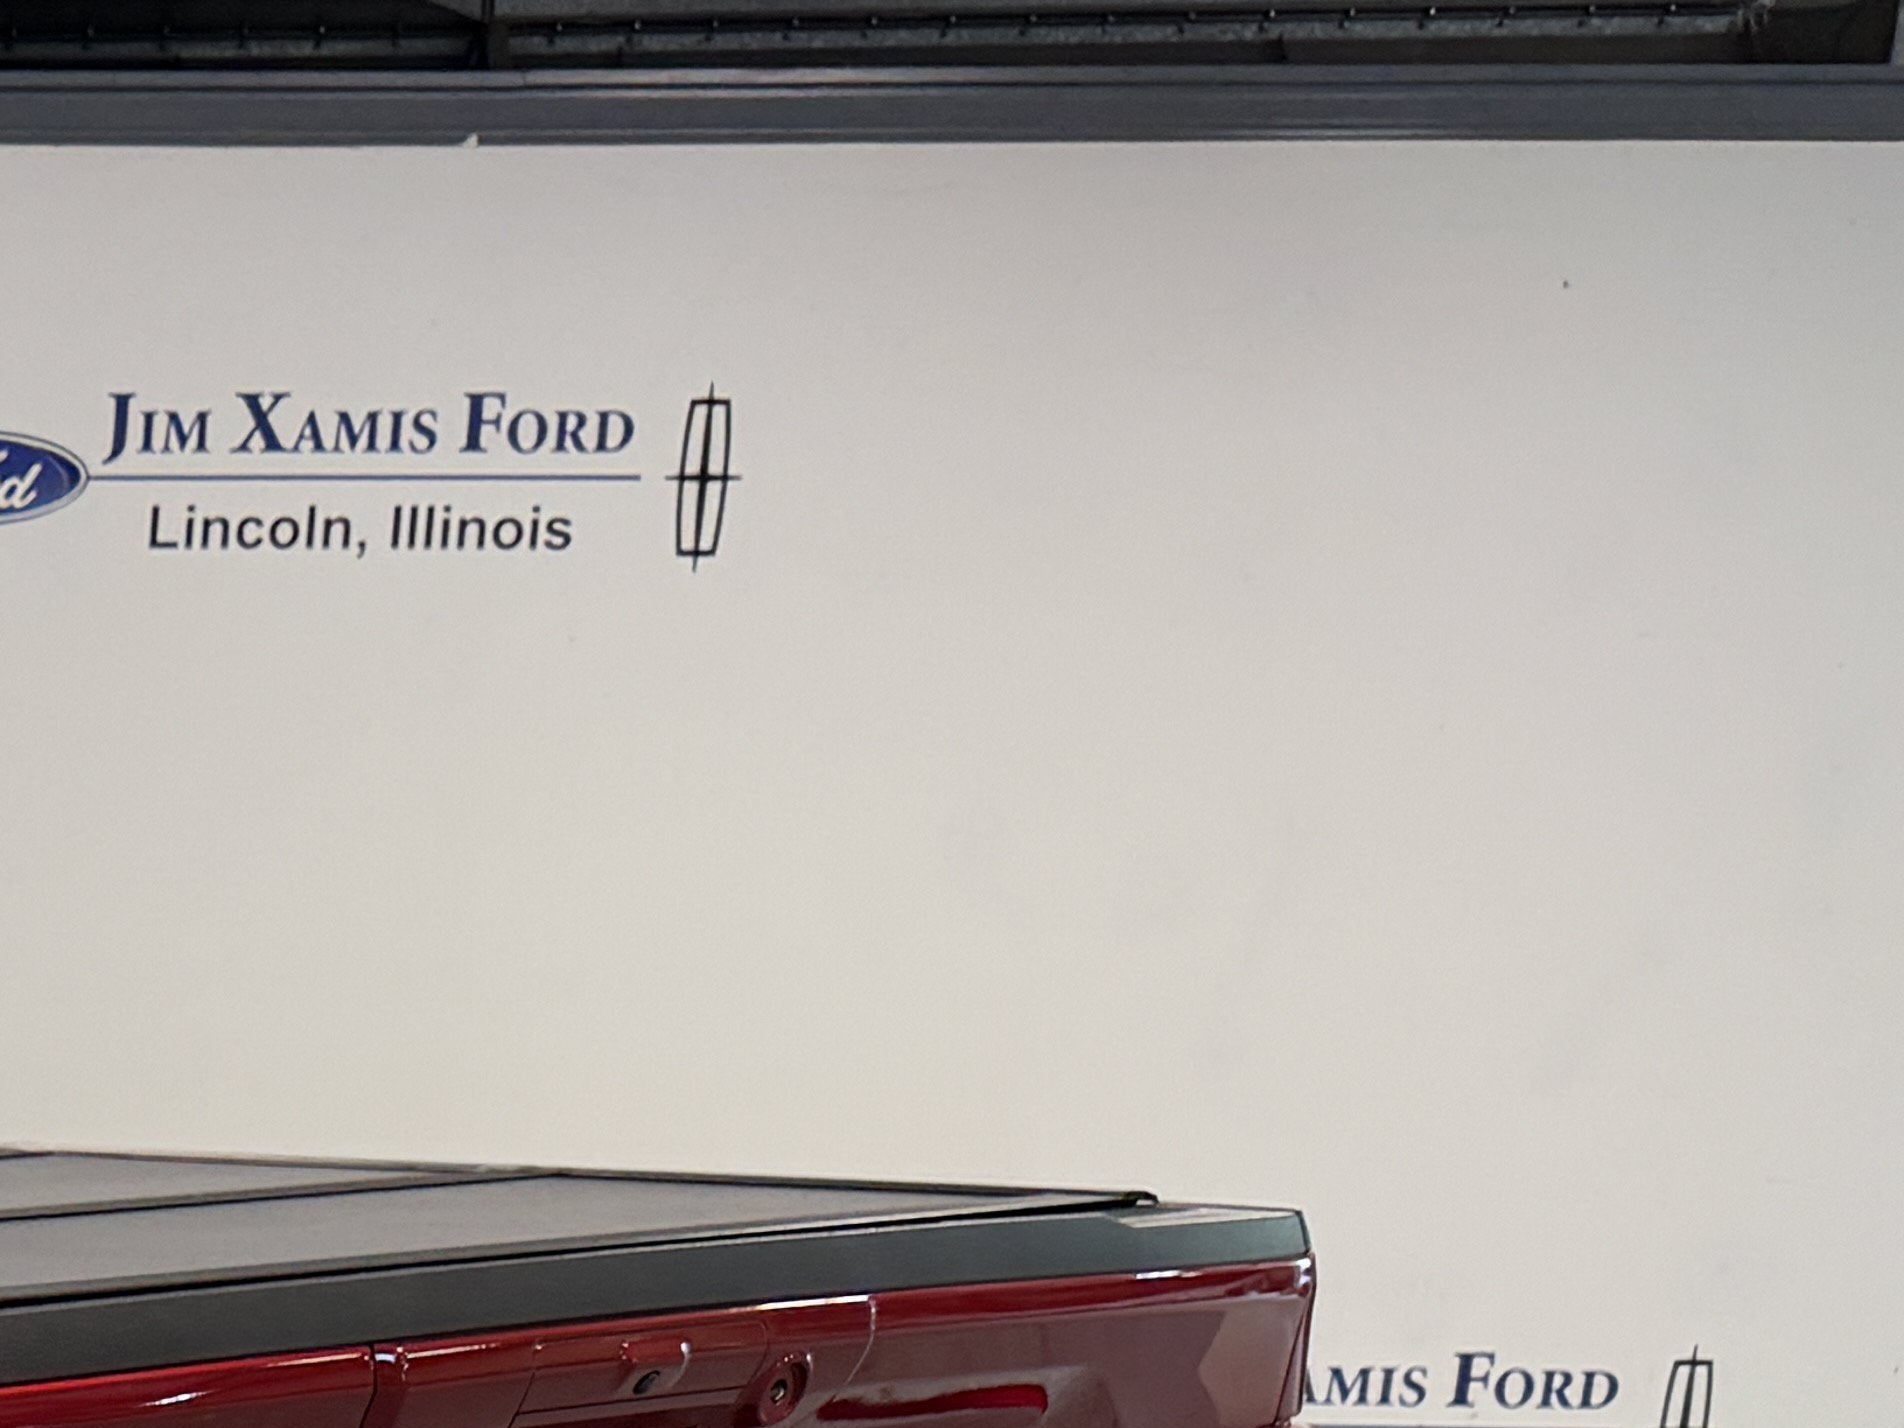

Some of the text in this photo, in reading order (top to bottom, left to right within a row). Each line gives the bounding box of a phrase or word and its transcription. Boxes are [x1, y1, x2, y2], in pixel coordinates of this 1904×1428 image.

[101, 392, 636, 465] JIM XAMIS FORD
[148, 504, 574, 558] Lincoln, Illinois
[1300, 1351, 1620, 1410] MIS FORD
